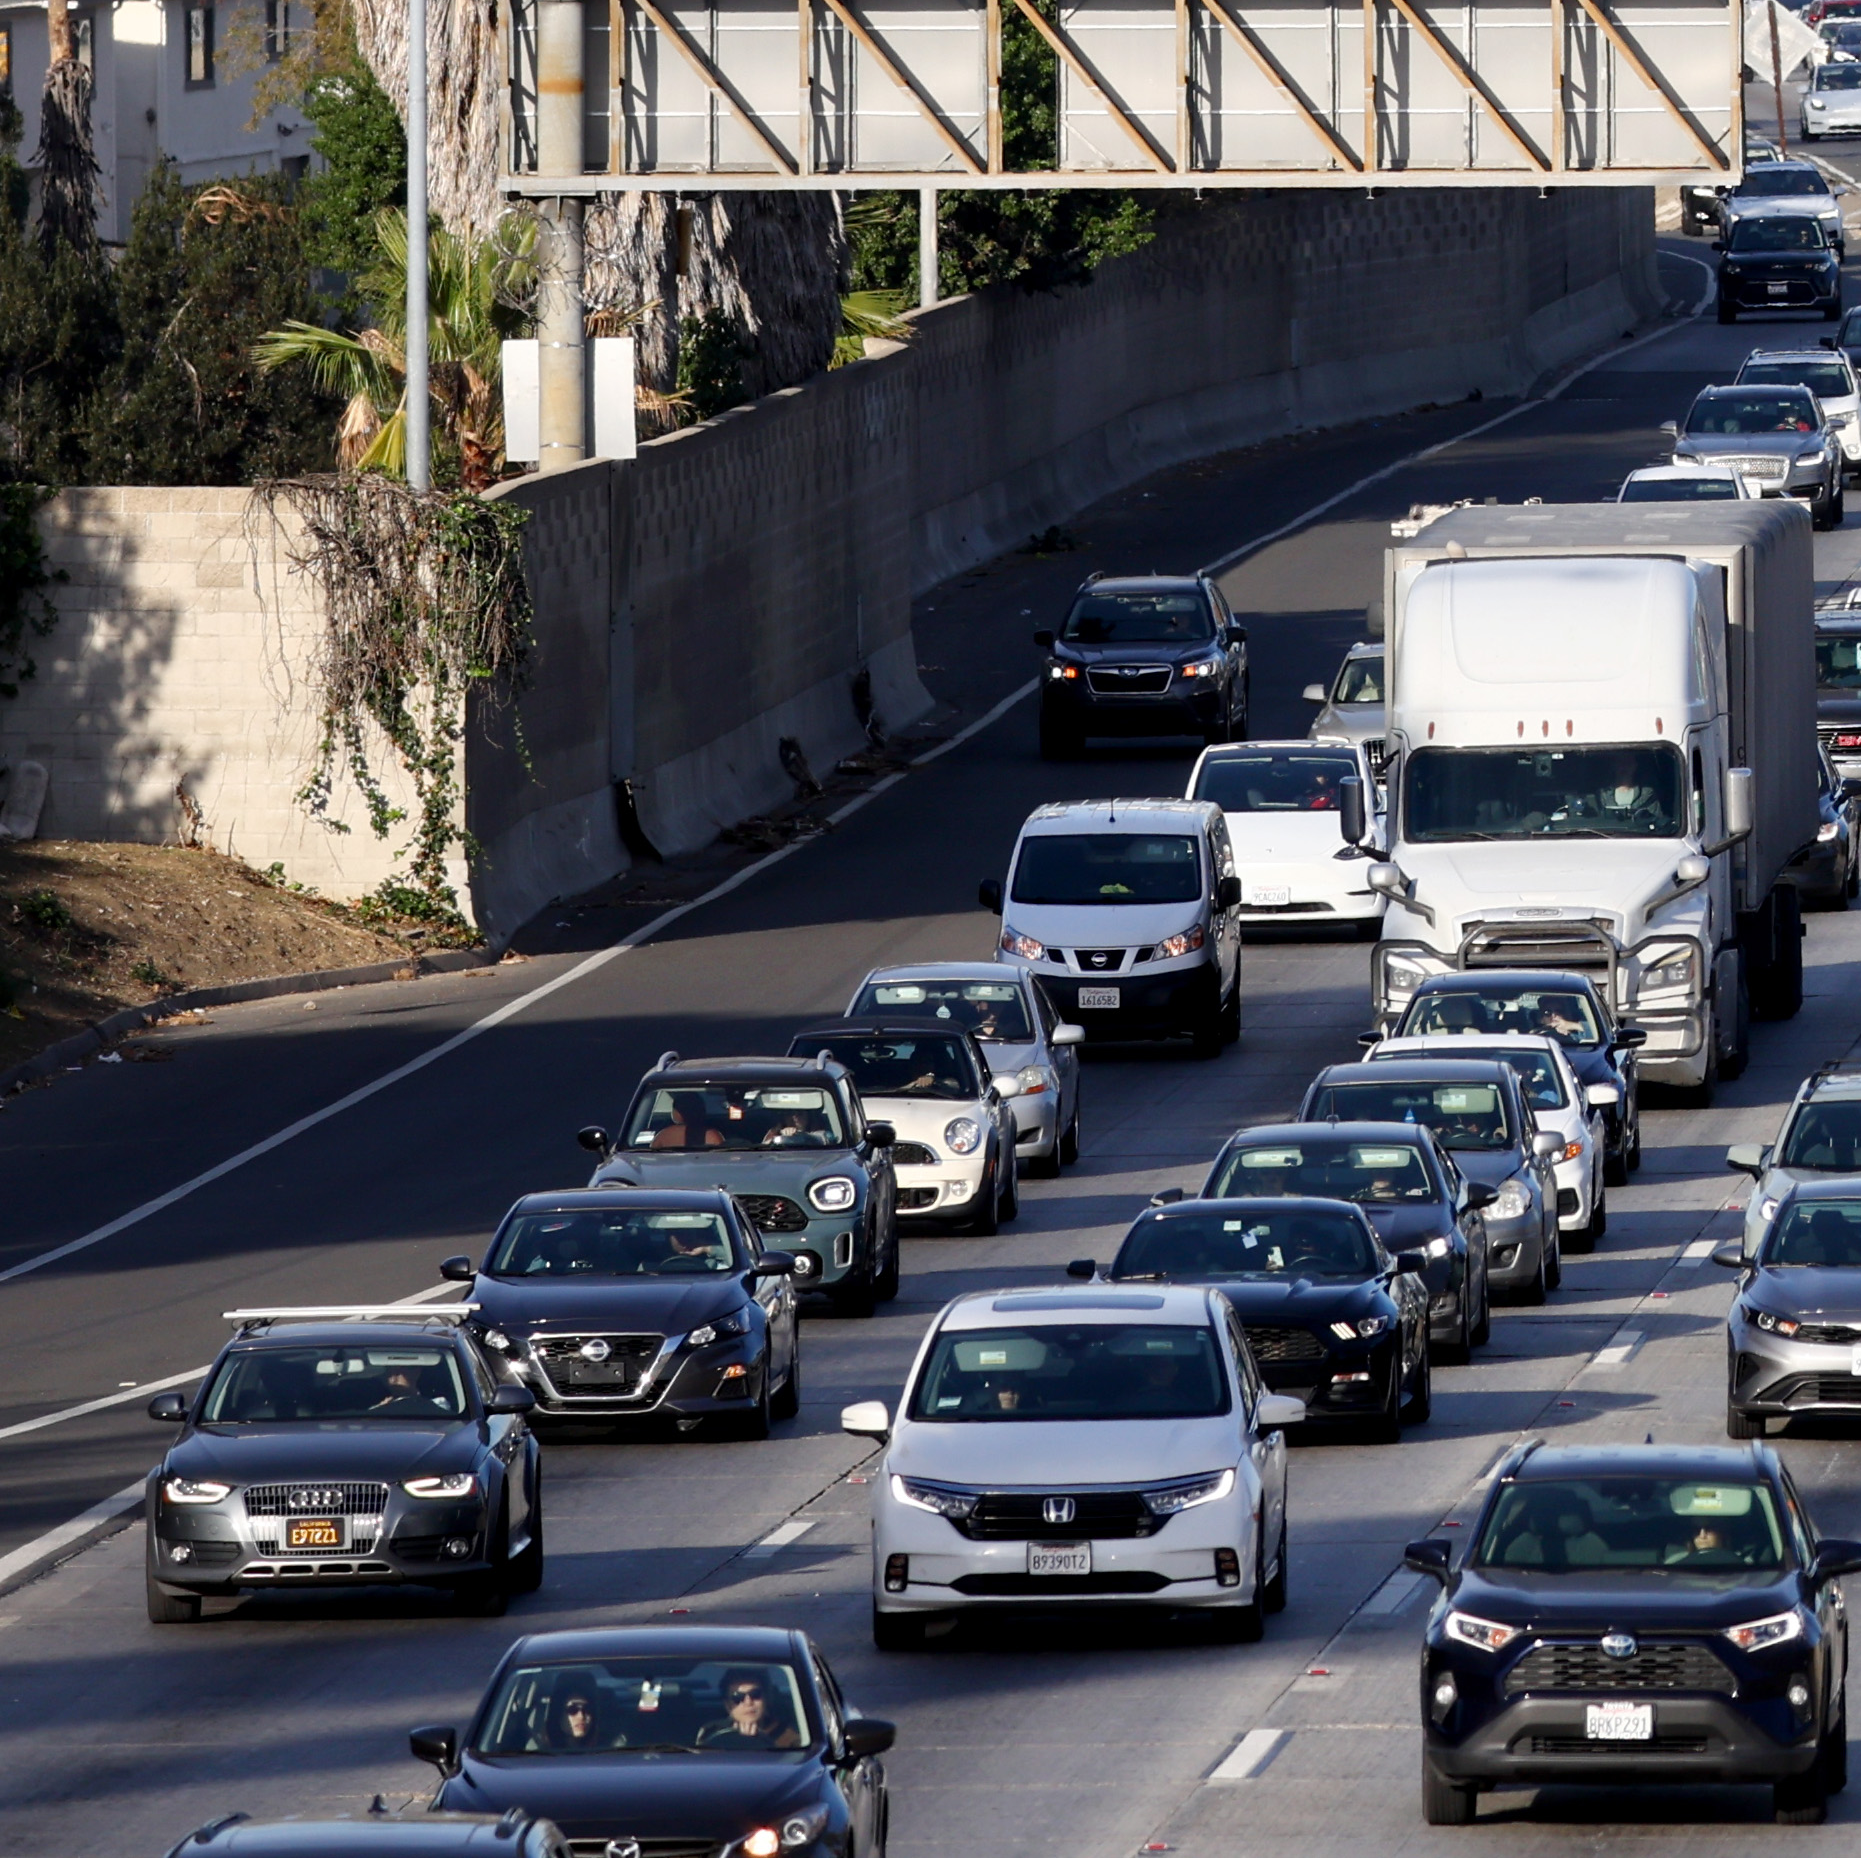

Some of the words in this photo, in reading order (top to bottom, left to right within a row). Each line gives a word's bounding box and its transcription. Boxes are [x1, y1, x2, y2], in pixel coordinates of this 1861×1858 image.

[1081, 994, 1118, 1006] 16165B2
[1032, 1554, 1086, 1571] 89390T2
[1589, 1716, 1649, 1736] 8RKP291
